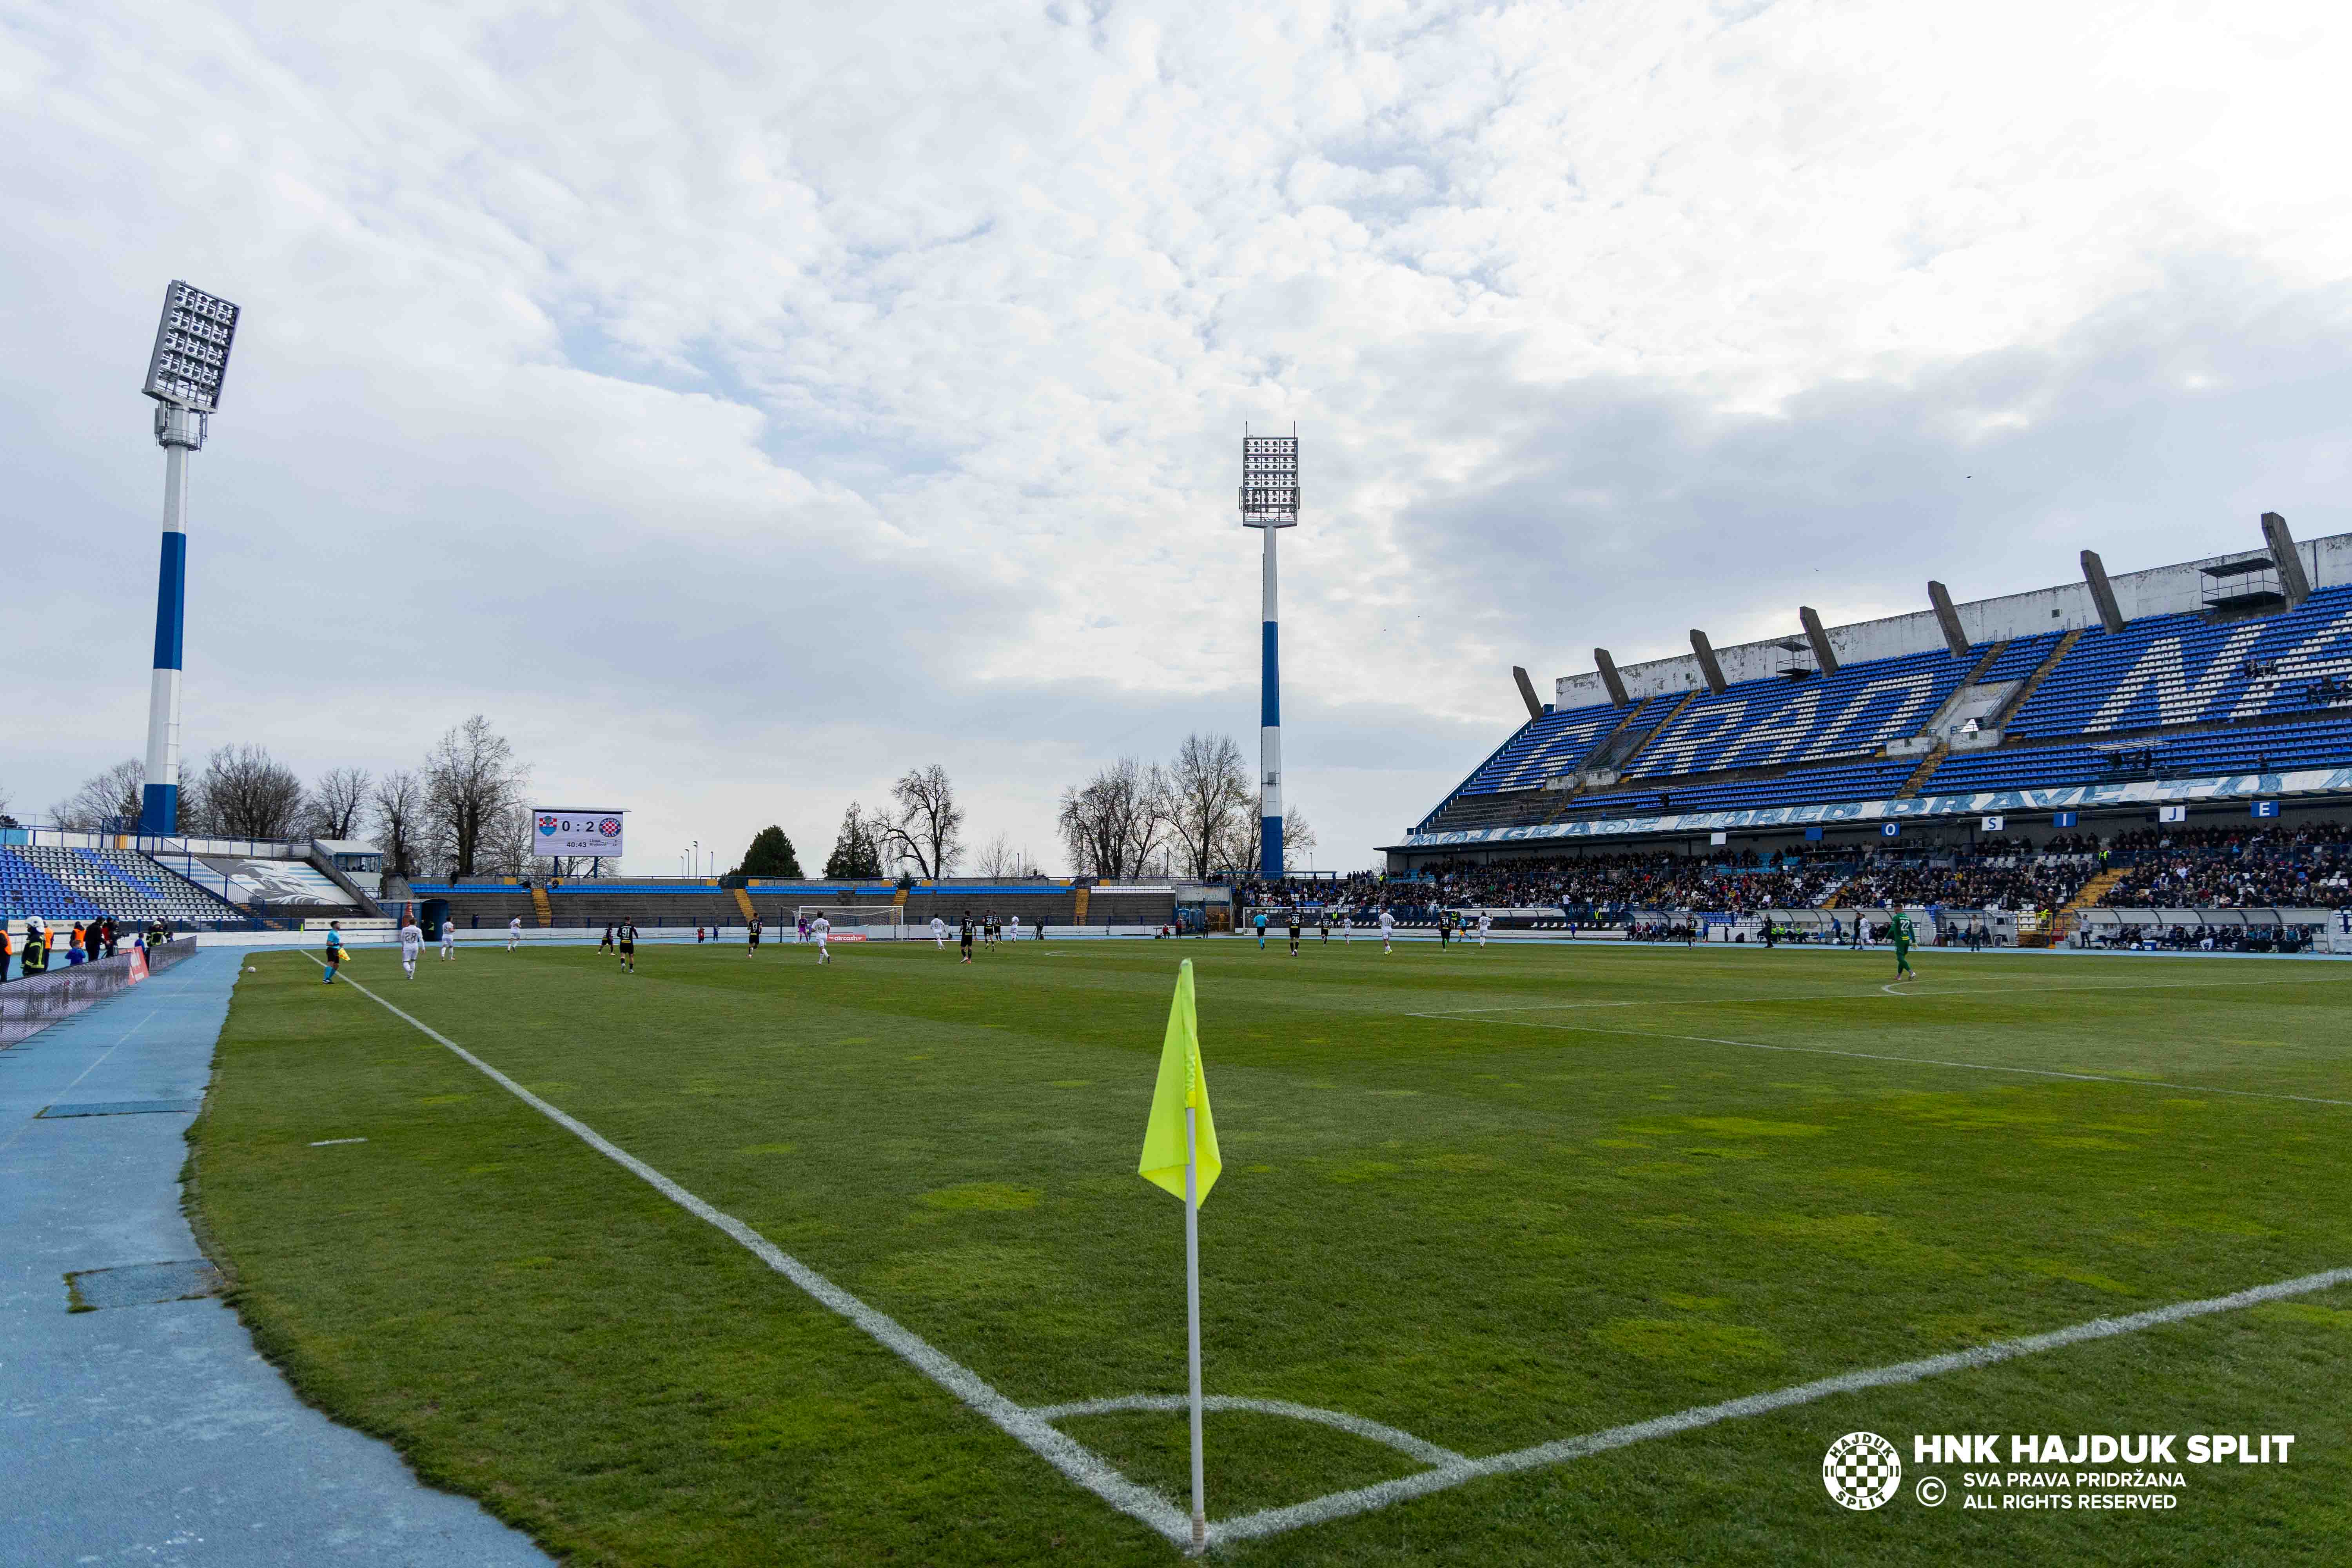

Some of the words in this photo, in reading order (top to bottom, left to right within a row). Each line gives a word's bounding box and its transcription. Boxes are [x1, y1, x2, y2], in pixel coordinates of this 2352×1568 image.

[1406, 828, 1493, 846] MOJ
[1500, 816, 1662, 841] GRADE
[1674, 802, 1863, 830] PORED
[1881, 783, 2126, 817] DRAVE
[1886, 824, 1895, 836] O
[1989, 817, 1996, 829] S
[2169, 807, 2177, 821] J
[2259, 802, 2270, 816] E
[562, 820, 570, 832] 0
[586, 821, 594, 832] 2
[1900, 920, 1910, 931] 22
[405, 932, 417, 942] 28
[622, 928, 630, 937] 91
